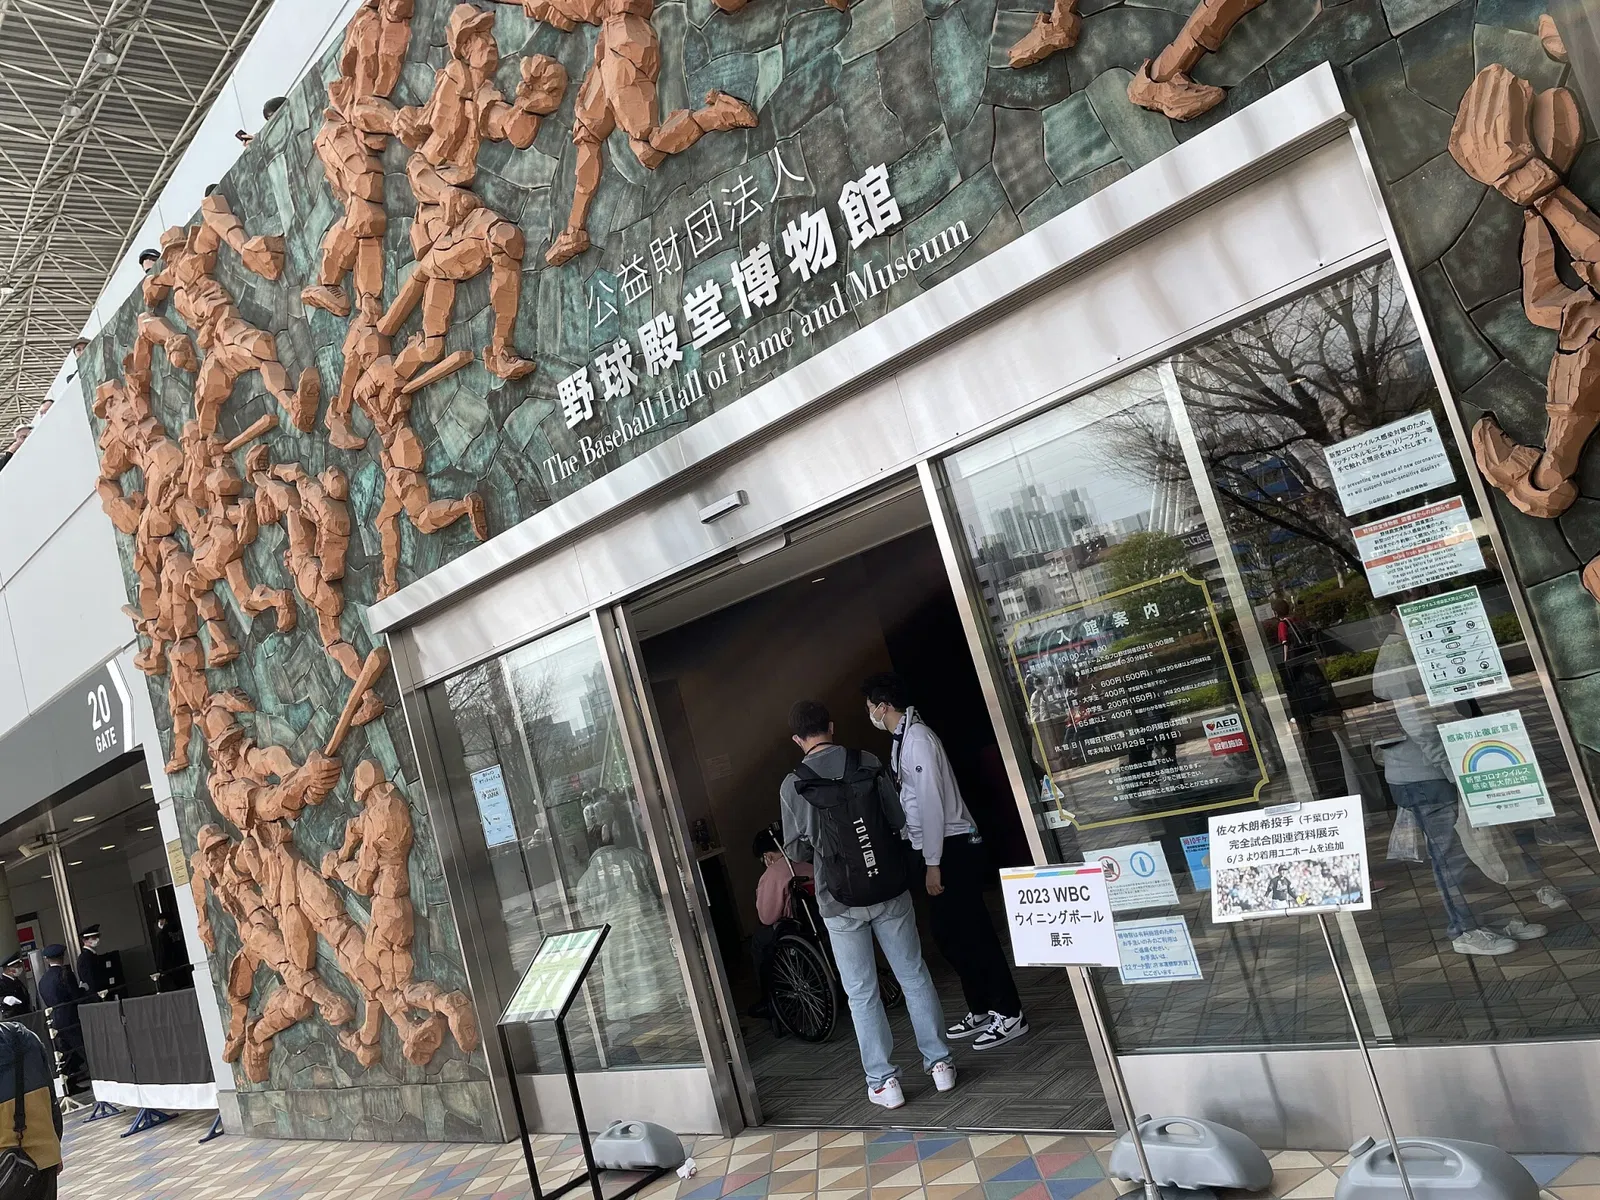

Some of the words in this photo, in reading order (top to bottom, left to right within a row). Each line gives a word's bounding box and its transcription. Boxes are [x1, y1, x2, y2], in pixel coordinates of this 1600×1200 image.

[587, 146, 805, 329] 公益財団法人
[556, 161, 902, 430] 野球殿堂博物館
[543, 453, 580, 486] The
[578, 396, 657, 467] Baseball
[656, 368, 705, 420] Hall
[707, 350, 730, 391] of
[729, 324, 795, 377] Fame
[800, 281, 849, 338] and
[846, 219, 973, 307] Museum
[1058, 602, 1160, 645] 入館案内
[1103, 686, 1125, 698] 400円
[88, 684, 111, 731] 20
[1110, 708, 1132, 720] 400円
[1216, 718, 1238, 729] AED
[95, 726, 118, 753] GATE
[1465, 766, 1530, 784] 新型コロナウイルス
[1229, 826, 1339, 850] 完全試合関連資料展示
[1226, 854, 1243, 864] 6/3
[1246, 841, 1344, 861] より着用ユニホームを追加
[1018, 888, 1050, 904] 2023
[1053, 885, 1090, 903] WBC
[1015, 909, 1104, 926] ウイニングボール
[1050, 932, 1073, 947] 展示
